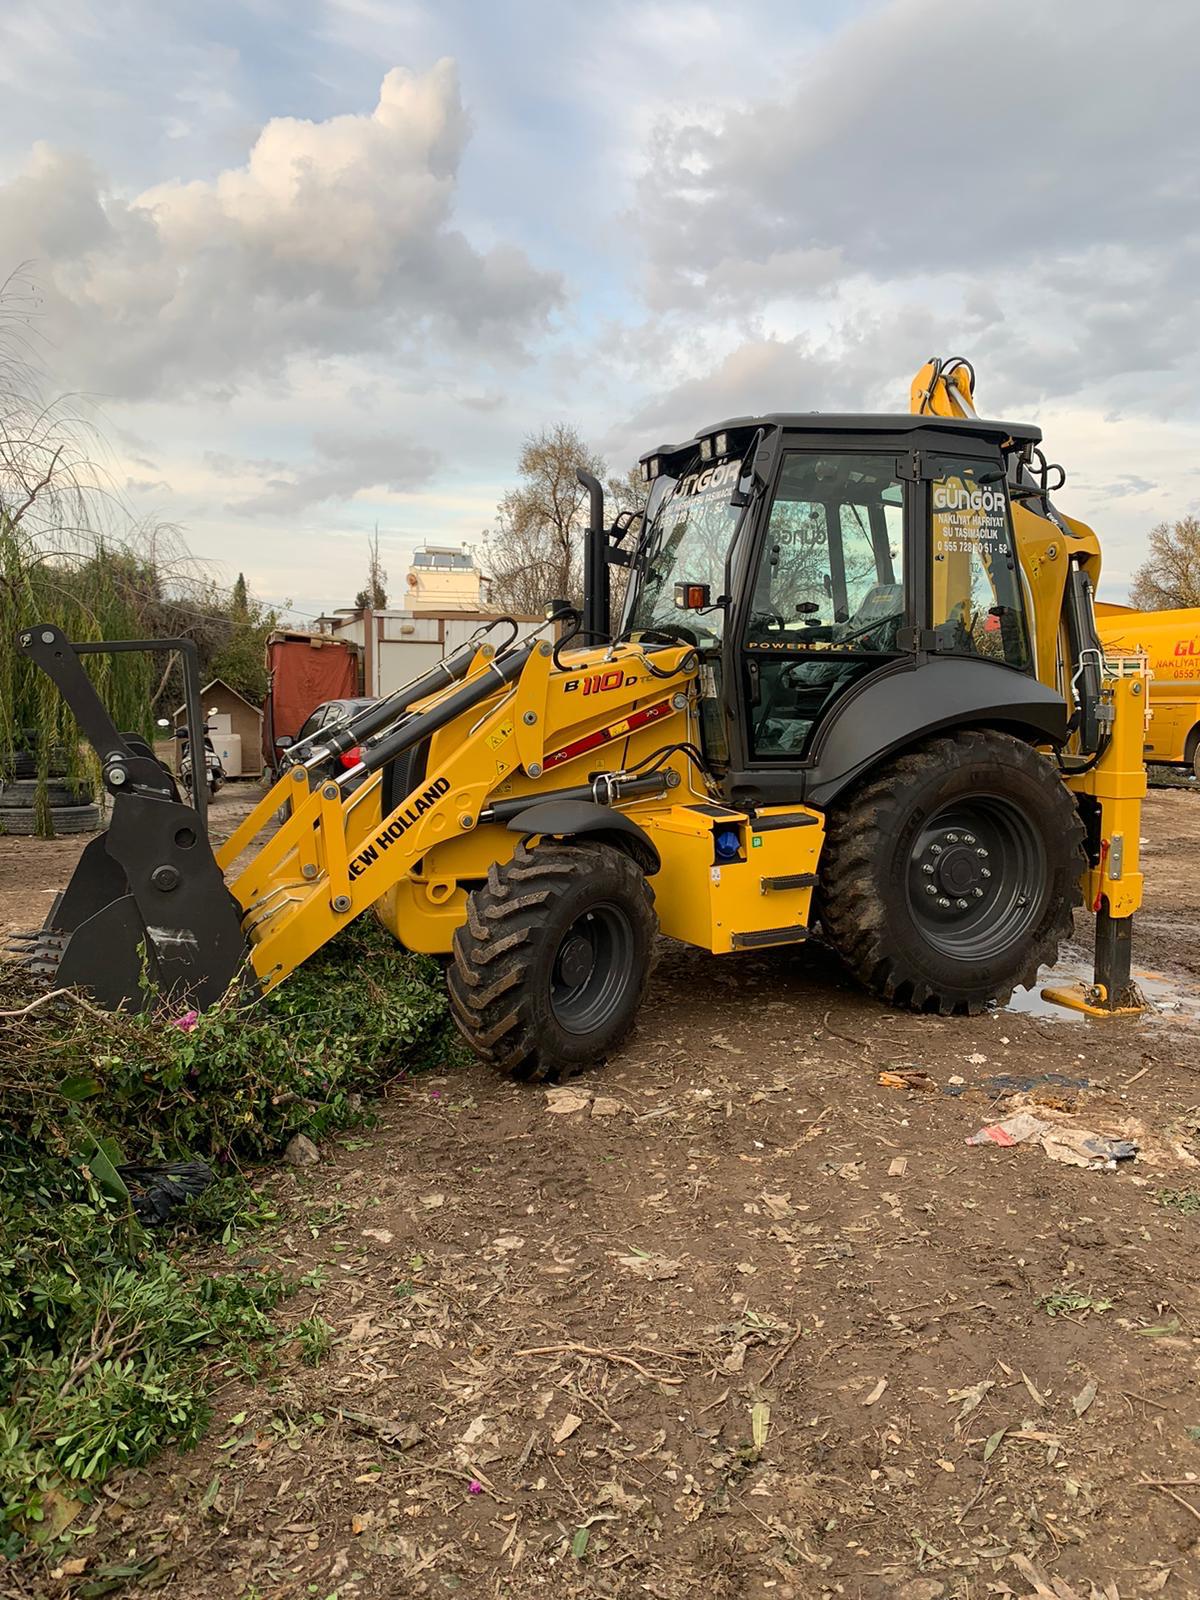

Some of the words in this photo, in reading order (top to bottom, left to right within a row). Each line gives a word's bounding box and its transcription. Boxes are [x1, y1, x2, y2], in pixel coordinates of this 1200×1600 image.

[934, 483, 1006, 512] GÜNGÖR
[942, 527, 954, 538] SU
[998, 543, 1008, 554] 52
[348, 844, 380, 882] EW
[375, 777, 451, 851] HOLLAND
